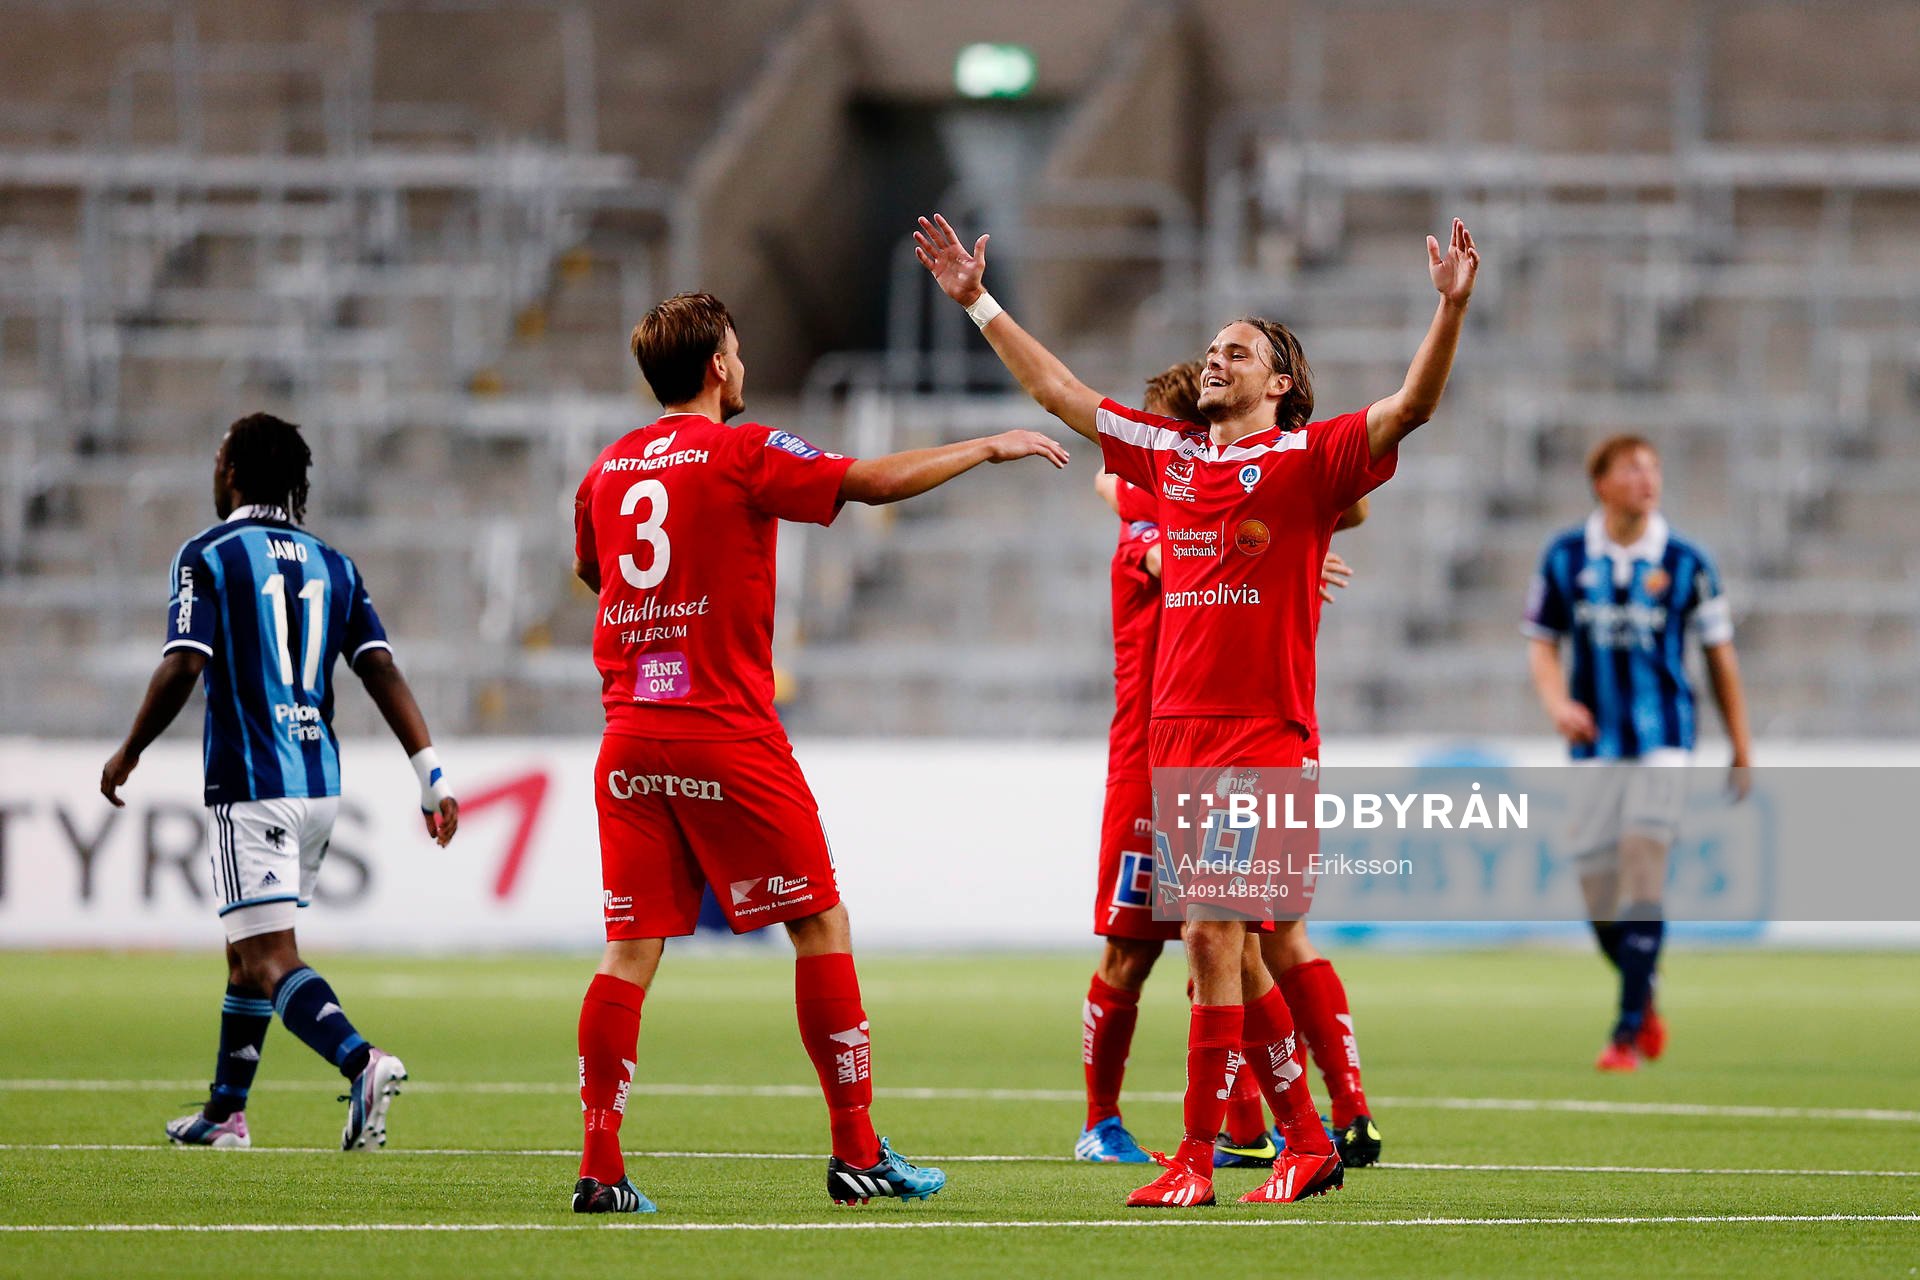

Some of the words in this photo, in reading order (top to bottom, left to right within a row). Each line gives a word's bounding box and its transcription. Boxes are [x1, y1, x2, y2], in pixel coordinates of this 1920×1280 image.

[602, 449, 709, 475] PARTNERTECH
[619, 479, 671, 590] 3
[265, 539, 308, 563] JAWO
[1173, 544, 1217, 560] Sparbank
[1165, 582, 1261, 609] team:olivia
[602, 594, 710, 628] Klädhuset
[261, 574, 325, 691] 11
[620, 624, 688, 645] FALERUM
[641, 659, 684, 678] TÄNK
[649, 678, 675, 693] OM
[607, 769, 724, 801] Corren
[855, 1045, 869, 1081] INTER
